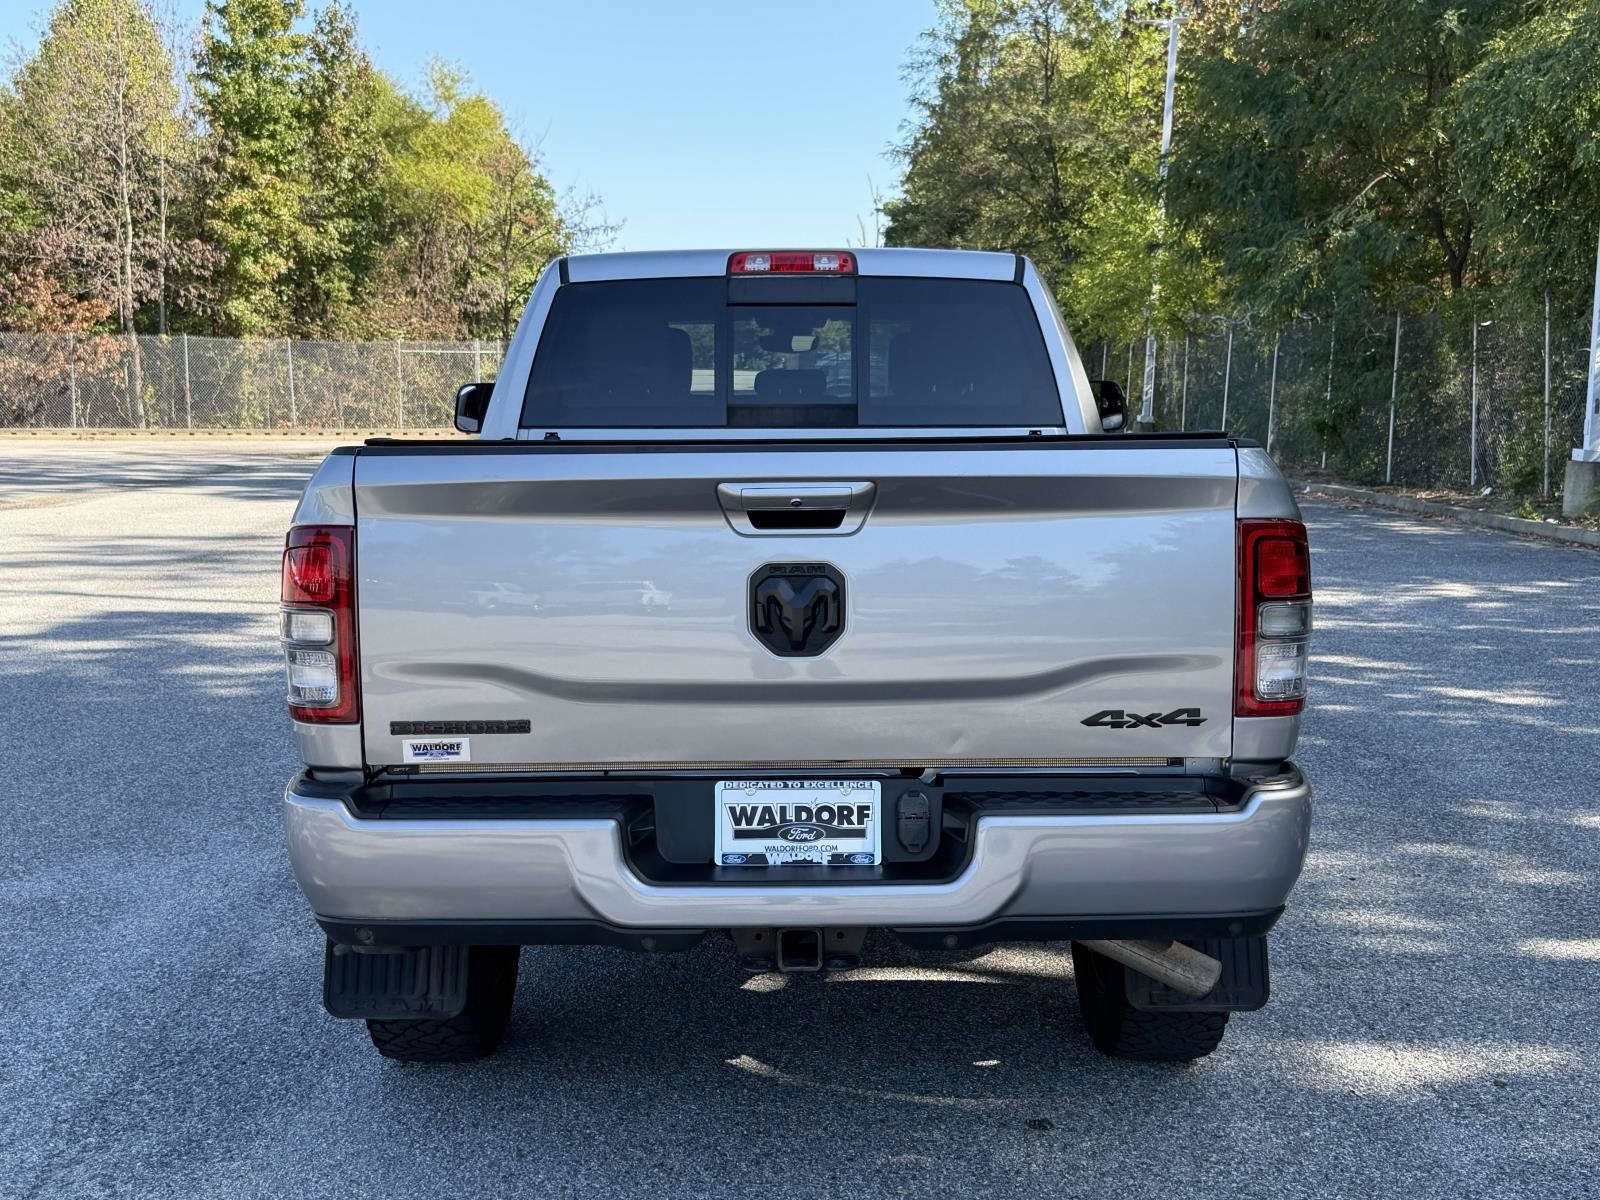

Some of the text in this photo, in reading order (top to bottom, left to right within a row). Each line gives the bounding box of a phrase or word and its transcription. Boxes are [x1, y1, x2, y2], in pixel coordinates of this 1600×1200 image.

[1080, 707, 1208, 729] 4x4
[412, 743, 462, 752] WALDORF
[725, 781, 873, 789] DEDICATED TO EXCELLENCE
[728, 804, 871, 827] WALDORF
[787, 827, 817, 841] Ford
[766, 852, 833, 866] WALDORF
